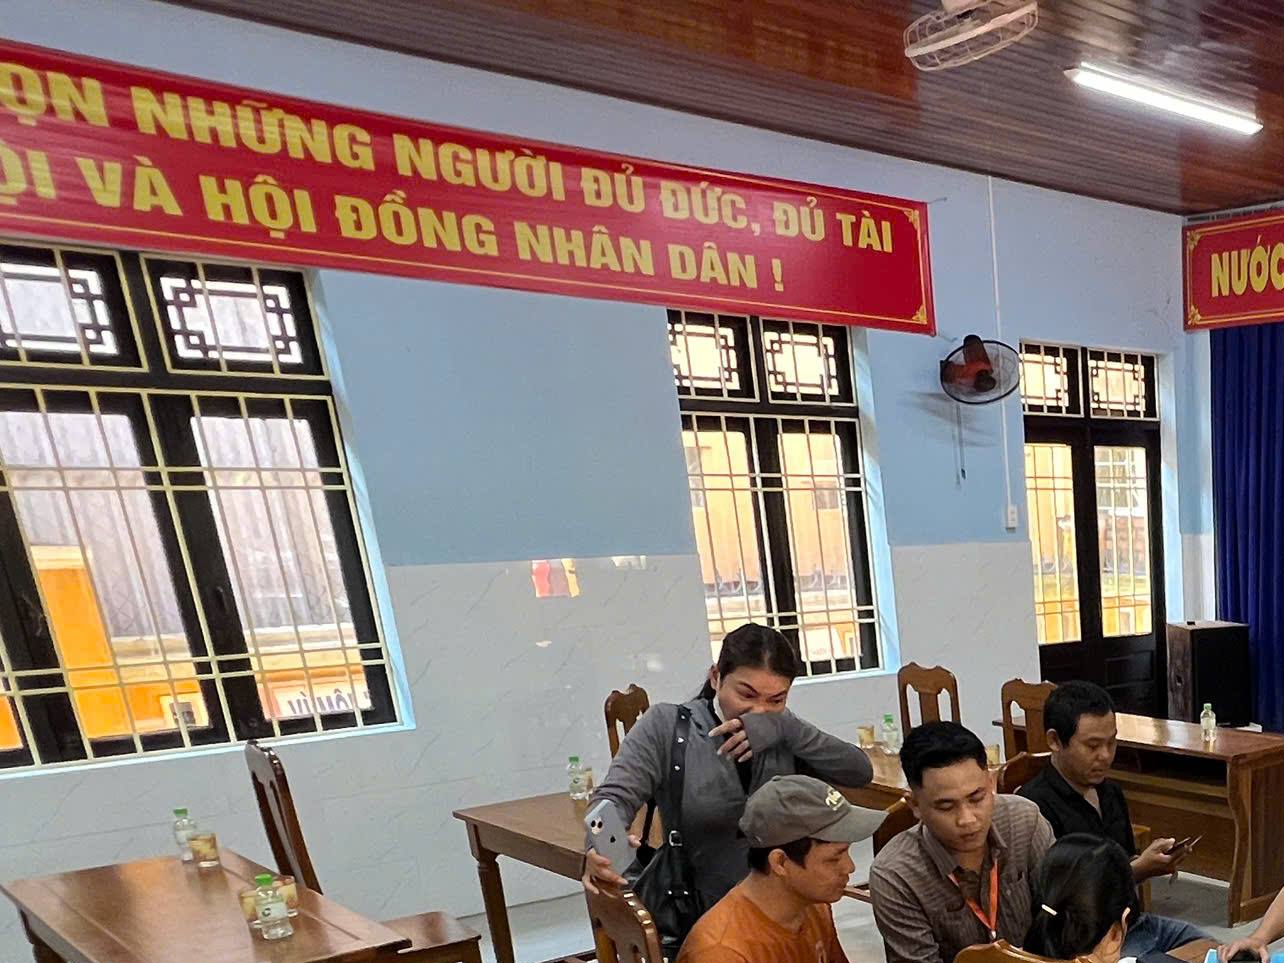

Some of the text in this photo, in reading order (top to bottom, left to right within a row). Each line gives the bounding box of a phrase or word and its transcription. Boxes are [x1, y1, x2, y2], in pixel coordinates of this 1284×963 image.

[75, 154, 184, 217] VÀ
[199, 173, 317, 239] HỘI
[334, 189, 499, 257] ĐỒNG
[513, 221, 655, 277] NHÂN
[668, 241, 759, 290] DÂN
[130, 86, 375, 172] NHỮNG
[393, 133, 566, 202] NGƯỜI
[580, 162, 645, 214] ĐỦ
[660, 181, 762, 236] ĐỨC,
[773, 196, 826, 243] ĐỦ
[836, 210, 894, 254] TÀI
